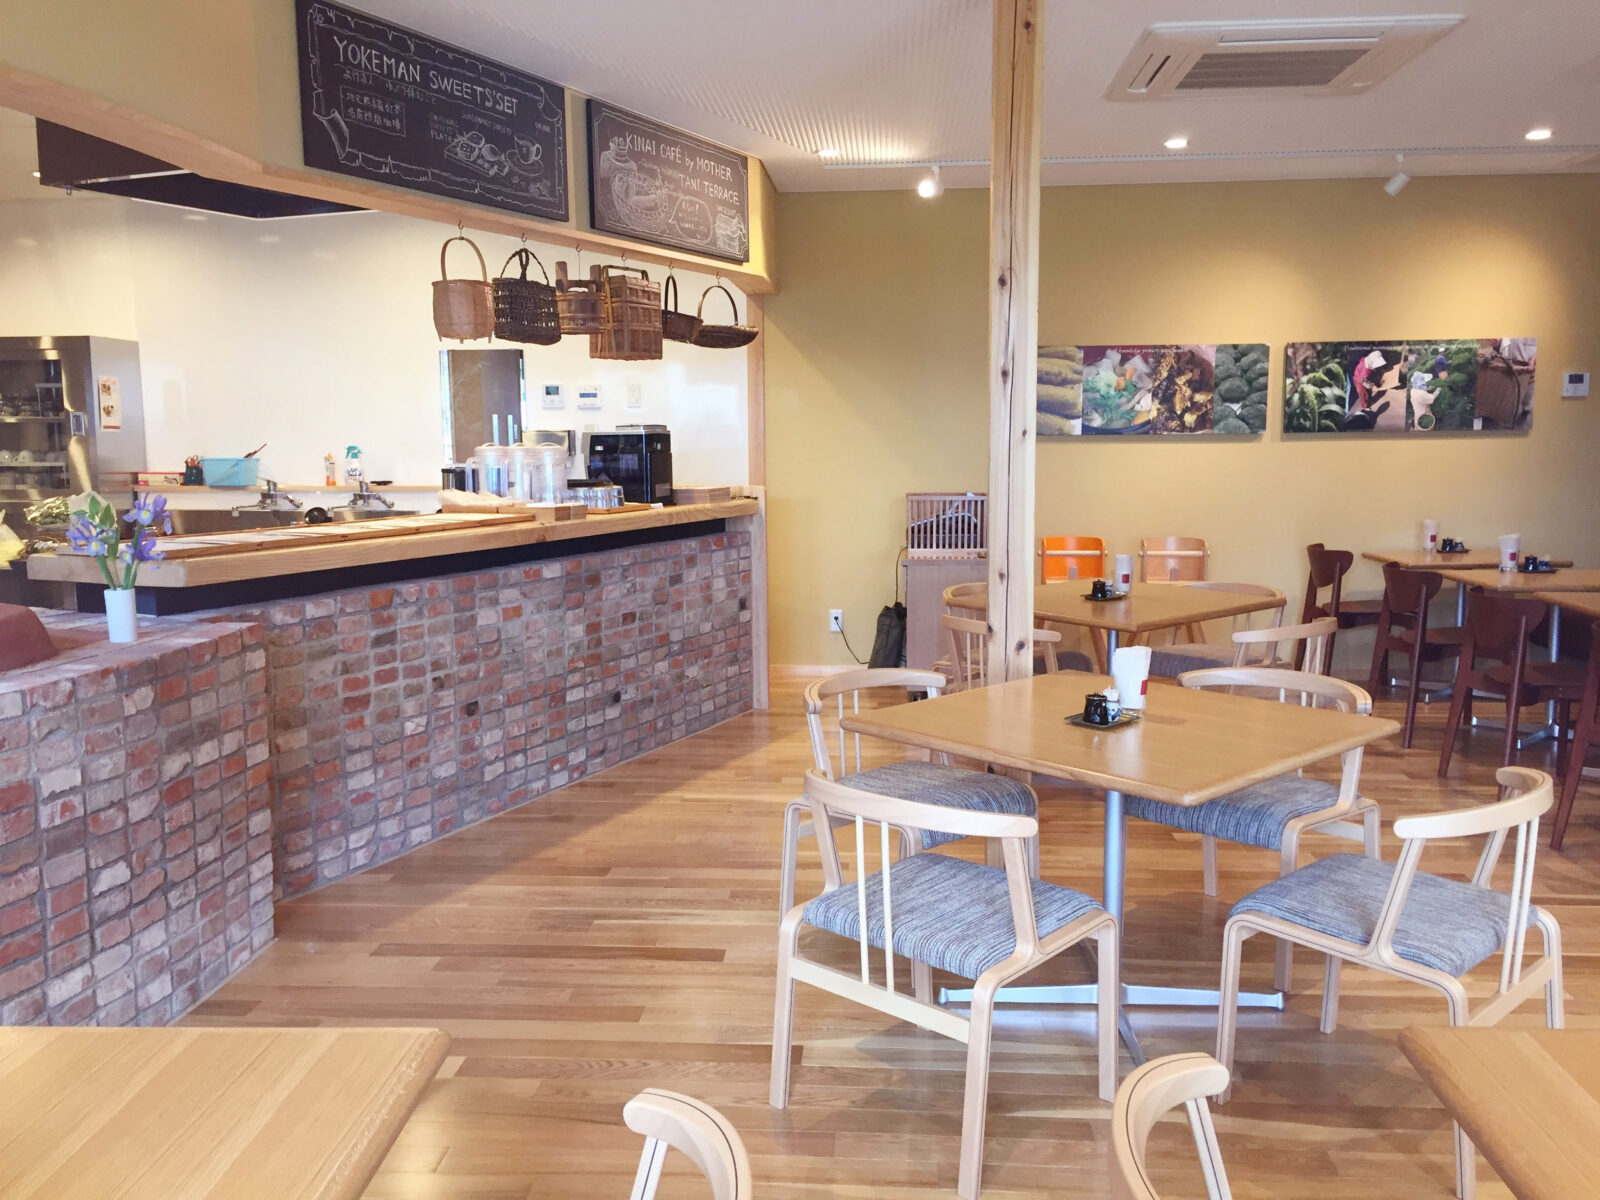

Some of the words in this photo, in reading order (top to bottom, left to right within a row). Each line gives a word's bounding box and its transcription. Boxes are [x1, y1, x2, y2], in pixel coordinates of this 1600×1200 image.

[333, 36, 421, 83] YOKEMAN
[430, 129, 454, 143] PLATE
[626, 132, 656, 155] KINAI
[660, 143, 682, 163] CAFÉ
[685, 152, 695, 172] by
[696, 156, 733, 182] MOTHER
[680, 173, 700, 190] TANI
[704, 182, 739, 204] TERRACE
